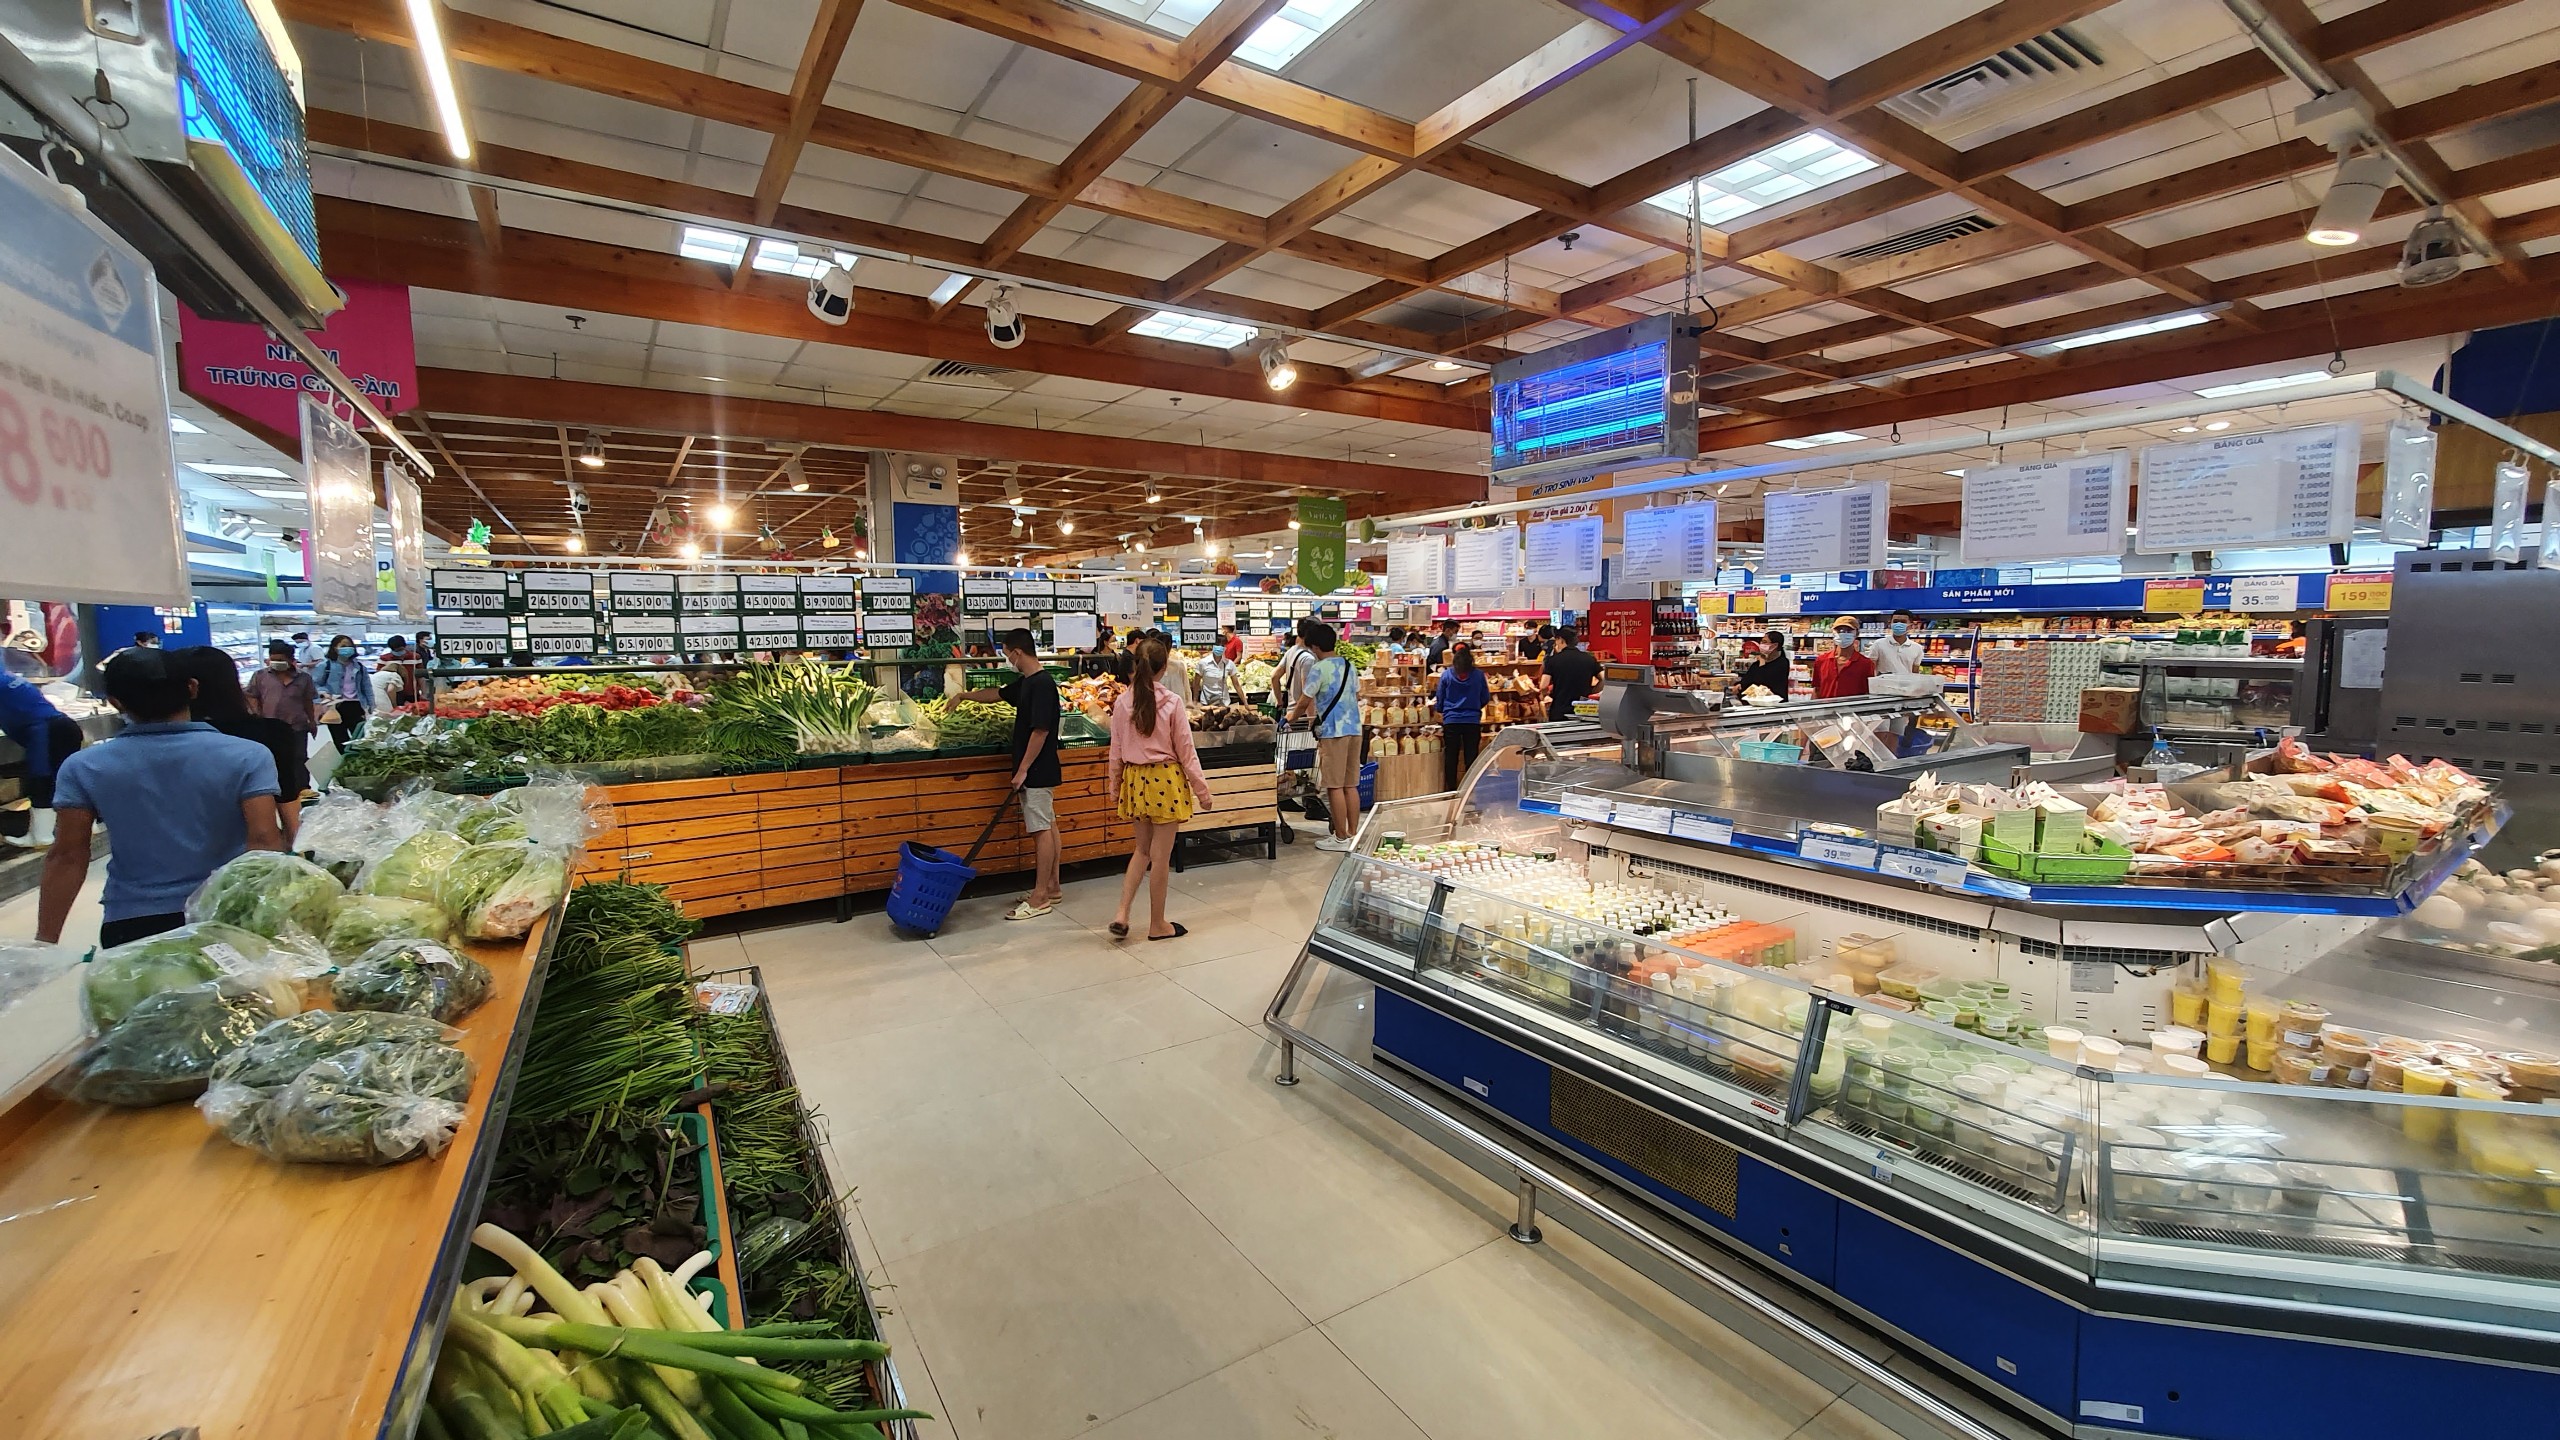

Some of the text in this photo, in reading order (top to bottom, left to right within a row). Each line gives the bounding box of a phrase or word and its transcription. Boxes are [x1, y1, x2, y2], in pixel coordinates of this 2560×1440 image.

[205, 366, 297, 390] TRỨNG
[2331, 576, 2364, 584] Khuyến
[1942, 588, 2015, 598] SẢN PHẨM MỚI
[440, 595, 492, 606] 79.500
[530, 595, 578, 606] 26.500
[617, 596, 662, 607] 46.500
[684, 597, 727, 607] 76.500
[746, 597, 786, 607] 45.000
[806, 597, 843, 607] 39.900
[874, 597, 902, 607] 7.900
[967, 598, 999, 607] 33.500
[1059, 600, 1087, 608] 24.000
[1601, 620, 1620, 636] 25
[534, 639, 581, 650] 80.000
[618, 637, 663, 649] 65.900
[686, 637, 728, 648] 55.500
[748, 635, 788, 646] 42.500
[807, 635, 846, 645] 71.500
[869, 635, 904, 645] 13.500
[443, 640, 494, 651] 52.900
